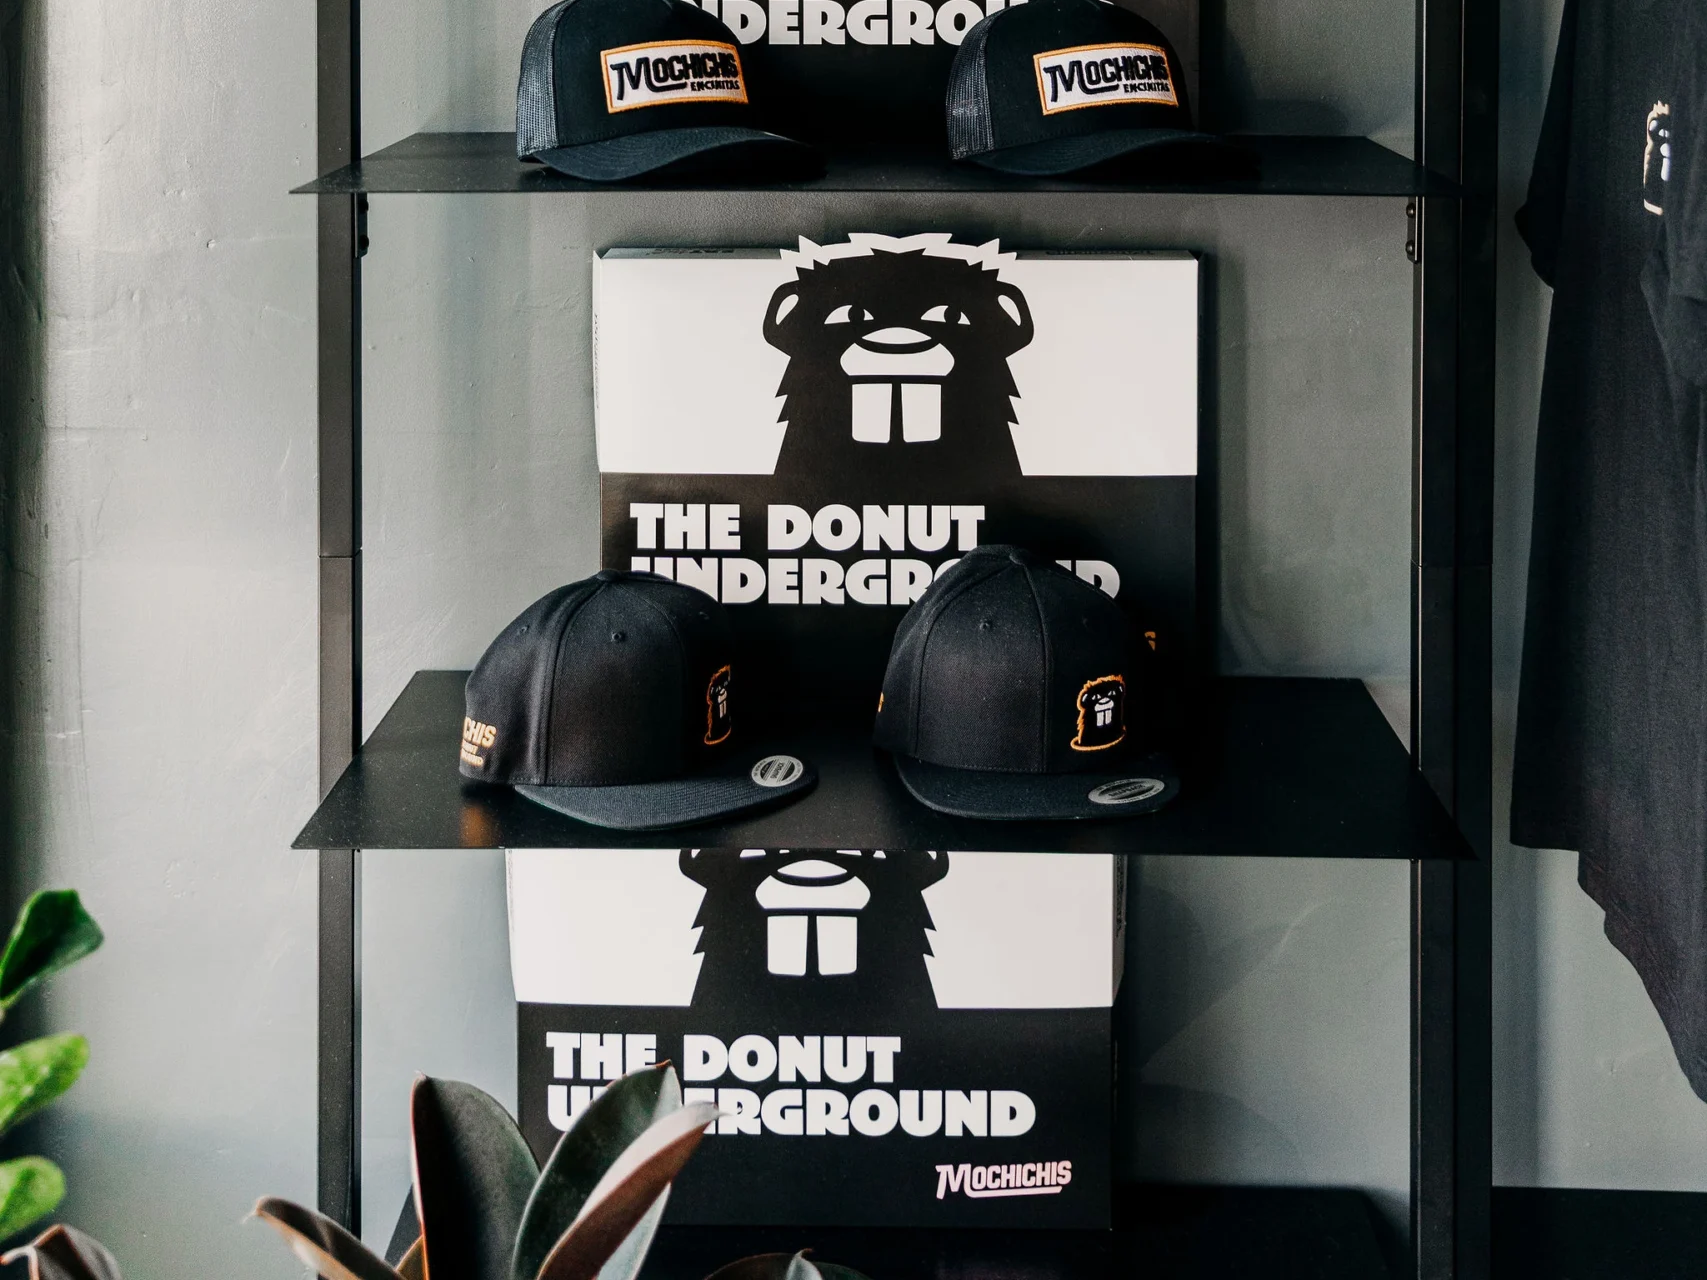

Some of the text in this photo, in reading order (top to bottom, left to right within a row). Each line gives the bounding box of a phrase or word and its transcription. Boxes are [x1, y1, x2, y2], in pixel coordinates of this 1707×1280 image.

[610, 52, 738, 101] MOCHICHIS
[690, 79, 740, 91] ENCINITAS
[1043, 54, 1168, 102] MOCHICHIS
[1123, 81, 1170, 93] ENCINITAS
[629, 502, 985, 552] THE DONUT
[546, 1031, 901, 1083] THE DONUT
[935, 1160, 1072, 1200] MOCHICHIS
